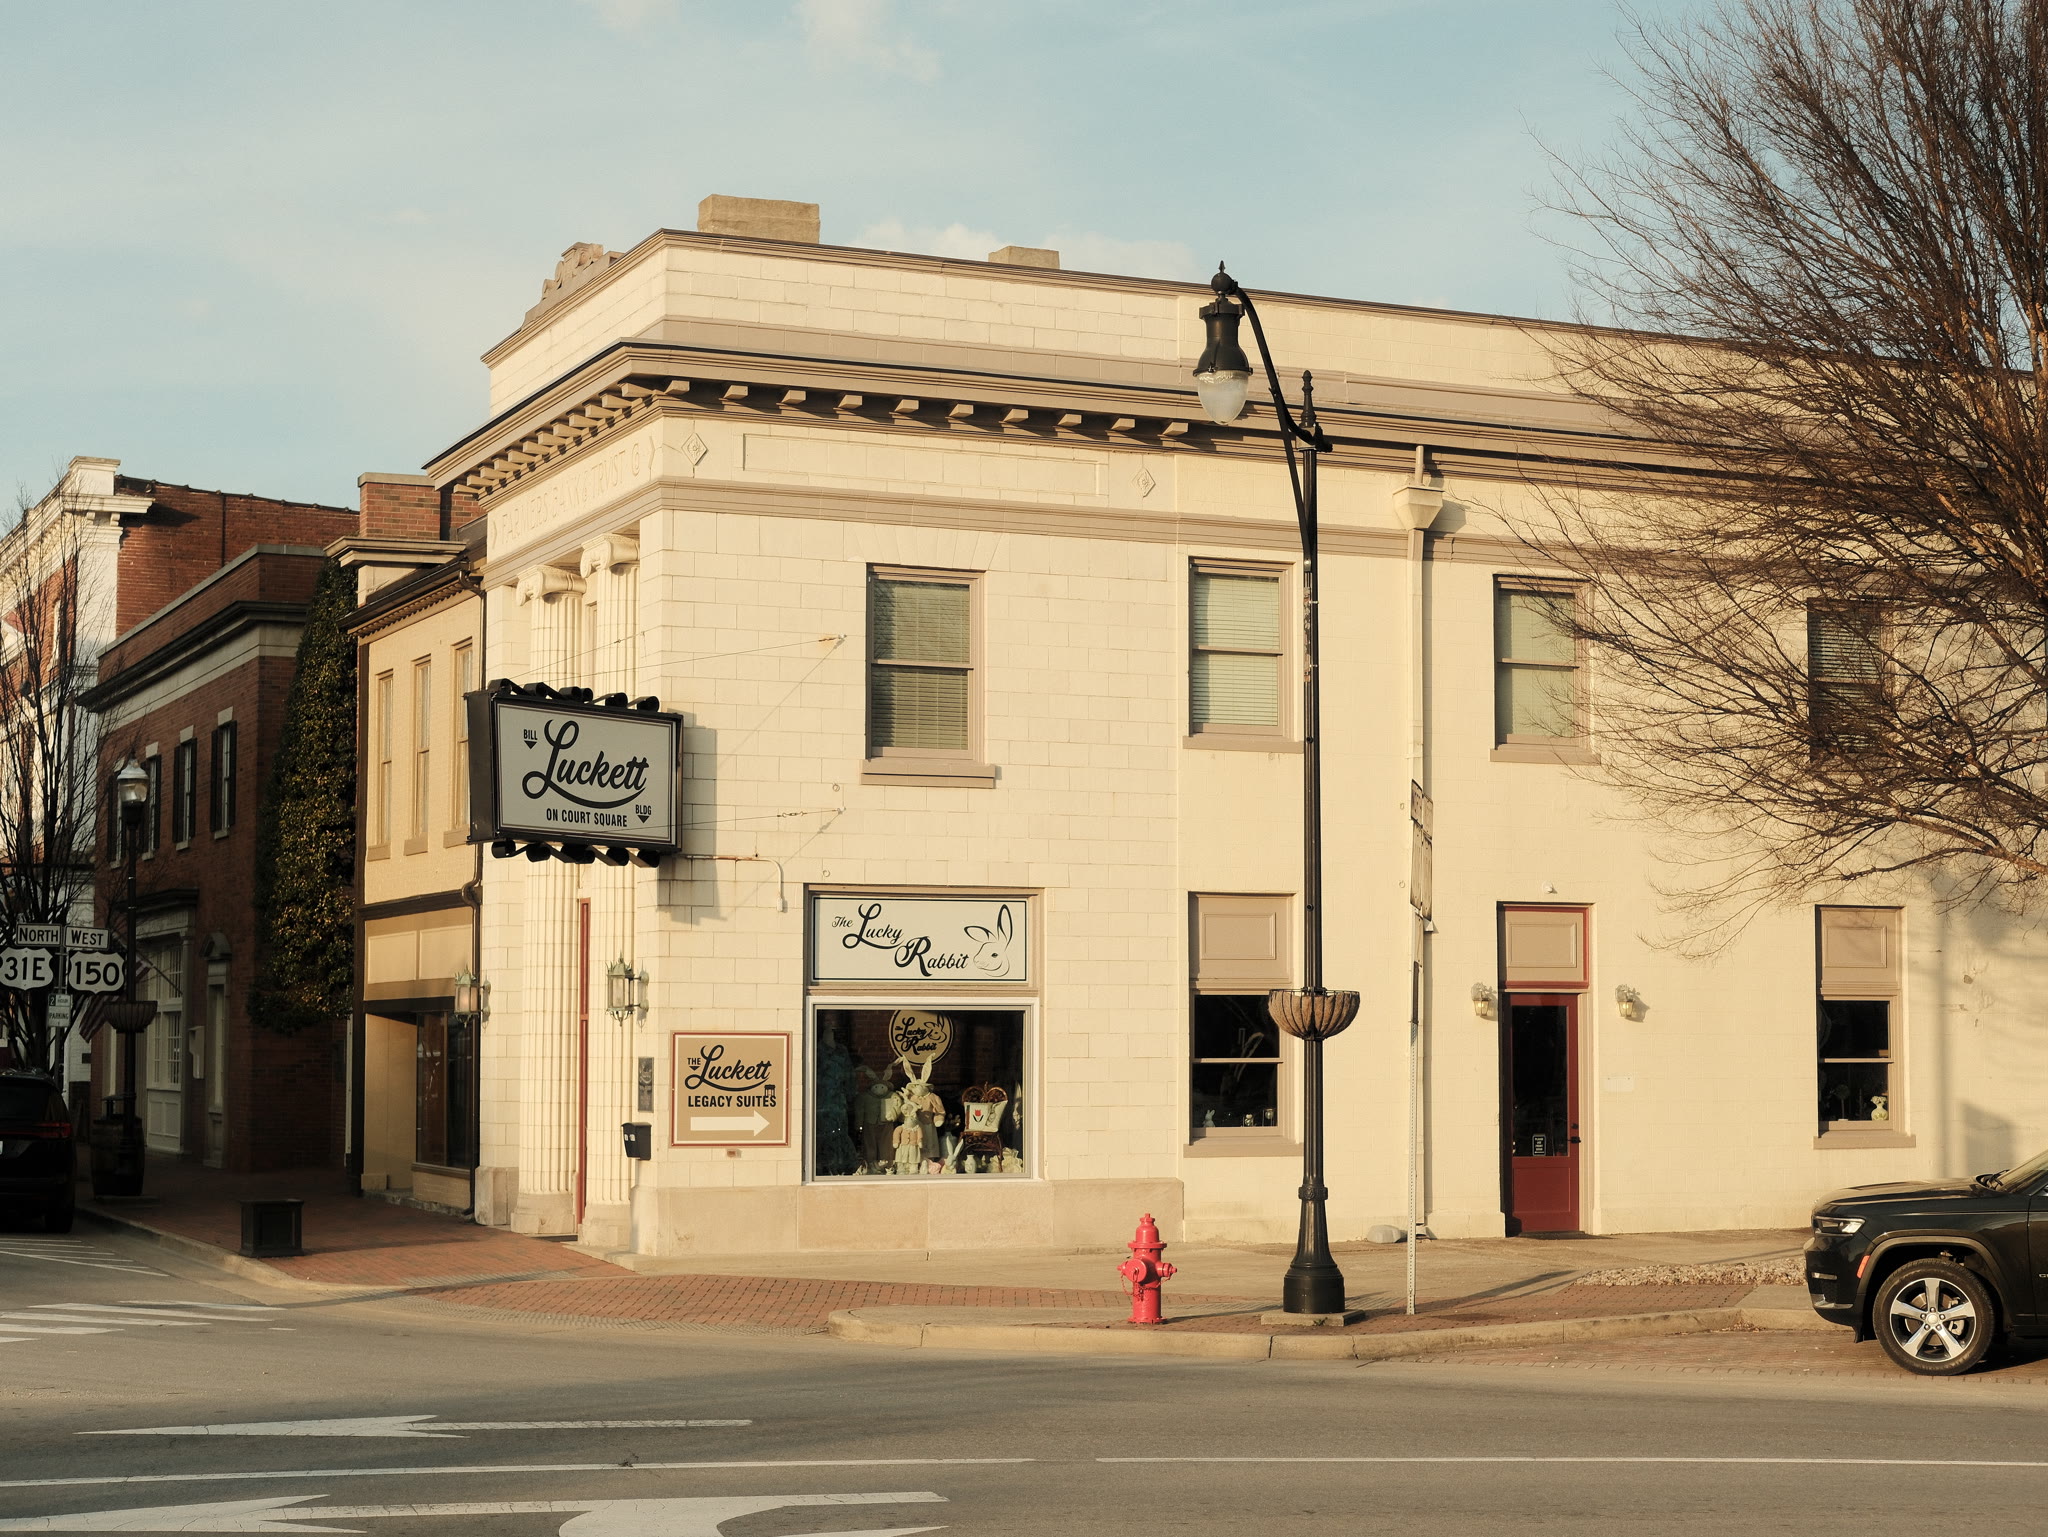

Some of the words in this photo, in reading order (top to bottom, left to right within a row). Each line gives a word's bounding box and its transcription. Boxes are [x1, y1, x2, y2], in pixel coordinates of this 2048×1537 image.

[523, 728, 538, 741] BILL
[522, 719, 650, 809] Luckett
[546, 808, 559, 821] ON
[561, 809, 591, 824] COURT
[594, 812, 628, 828] SQUARE
[635, 804, 652, 816] BLDG
[831, 915, 853, 929] The
[842, 903, 904, 950] Lucky
[19, 927, 59, 942] NORTH
[71, 929, 104, 945] WEST
[894, 935, 969, 977] Rabbit
[4, 956, 46, 981] 31E
[75, 960, 120, 986] 150
[895, 1016, 928, 1042] Lucky
[901, 1036, 938, 1056] Rabbit
[685, 1044, 772, 1092] Luckett
[687, 1057, 701, 1066] THE
[688, 1095, 732, 1108] LEGACY
[736, 1095, 777, 1108] SUITES
